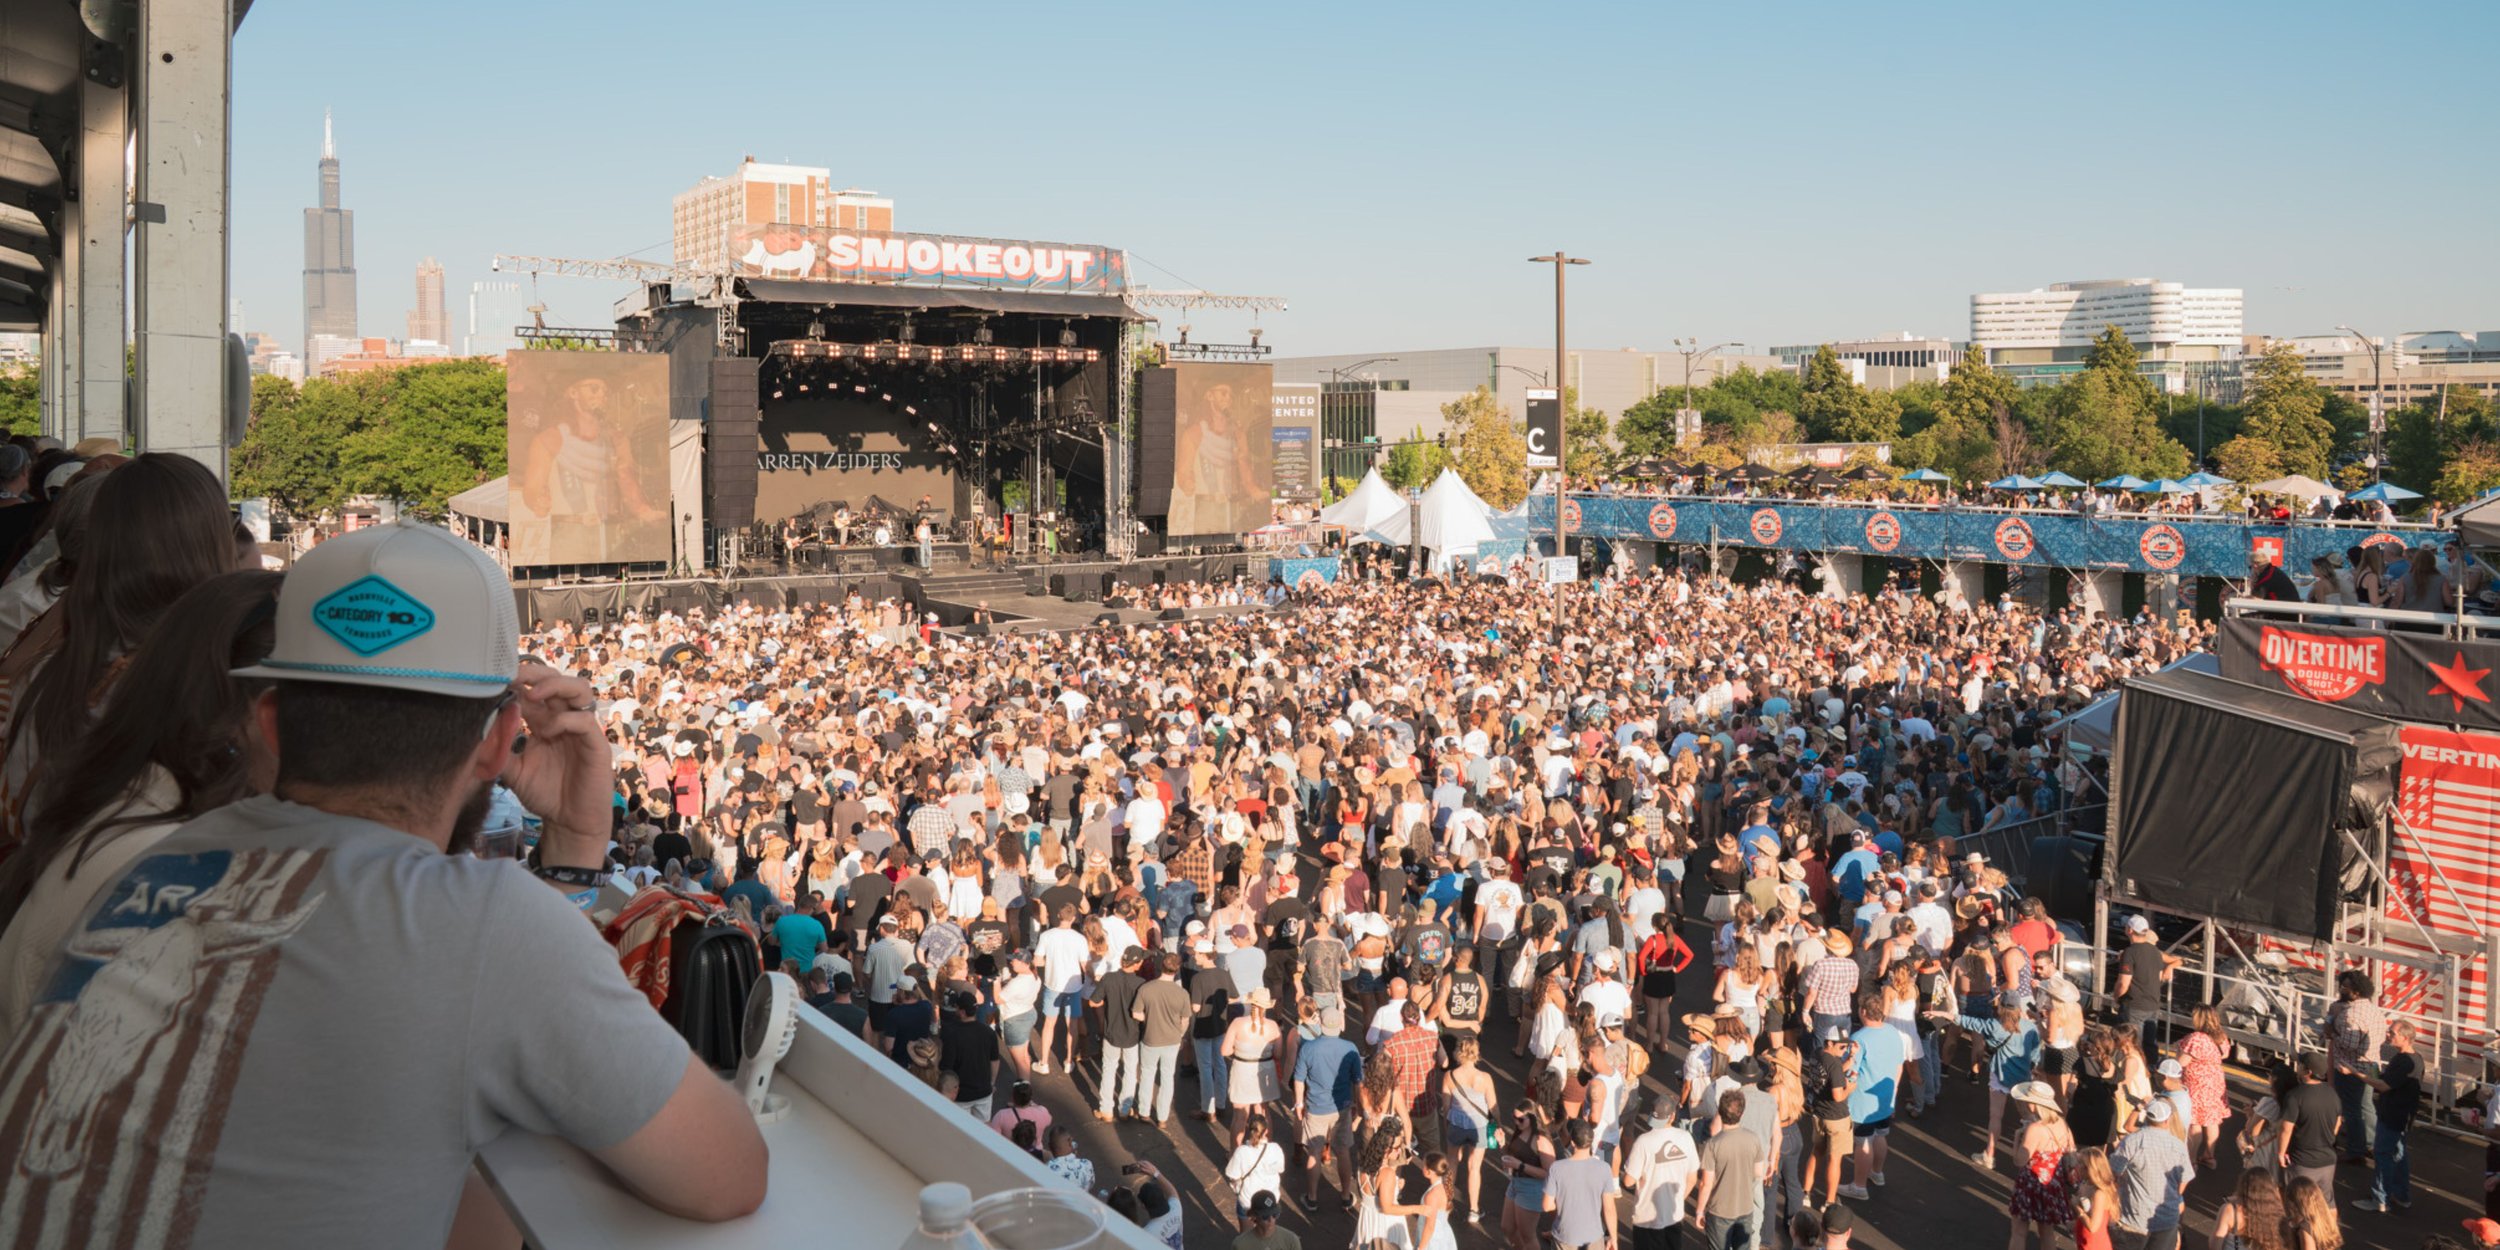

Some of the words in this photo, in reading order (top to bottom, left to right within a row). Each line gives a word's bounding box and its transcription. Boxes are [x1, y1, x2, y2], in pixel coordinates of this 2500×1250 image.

[827, 234, 1095, 281] SMOKEOUT
[1272, 408, 1315, 417] ENTER
[1527, 427, 1546, 454] C
[757, 453, 818, 470] ARREN
[824, 452, 902, 470] ZEIDERS
[328, 607, 385, 623] CATEGORY
[387, 611, 415, 625] 10
[2265, 633, 2379, 677] OVERTIME
[2298, 669, 2344, 683] DOUBLE
[2306, 679, 2333, 689] SHOT
[2401, 741, 2500, 770] VERTI
[1451, 994, 1478, 1016] 34
